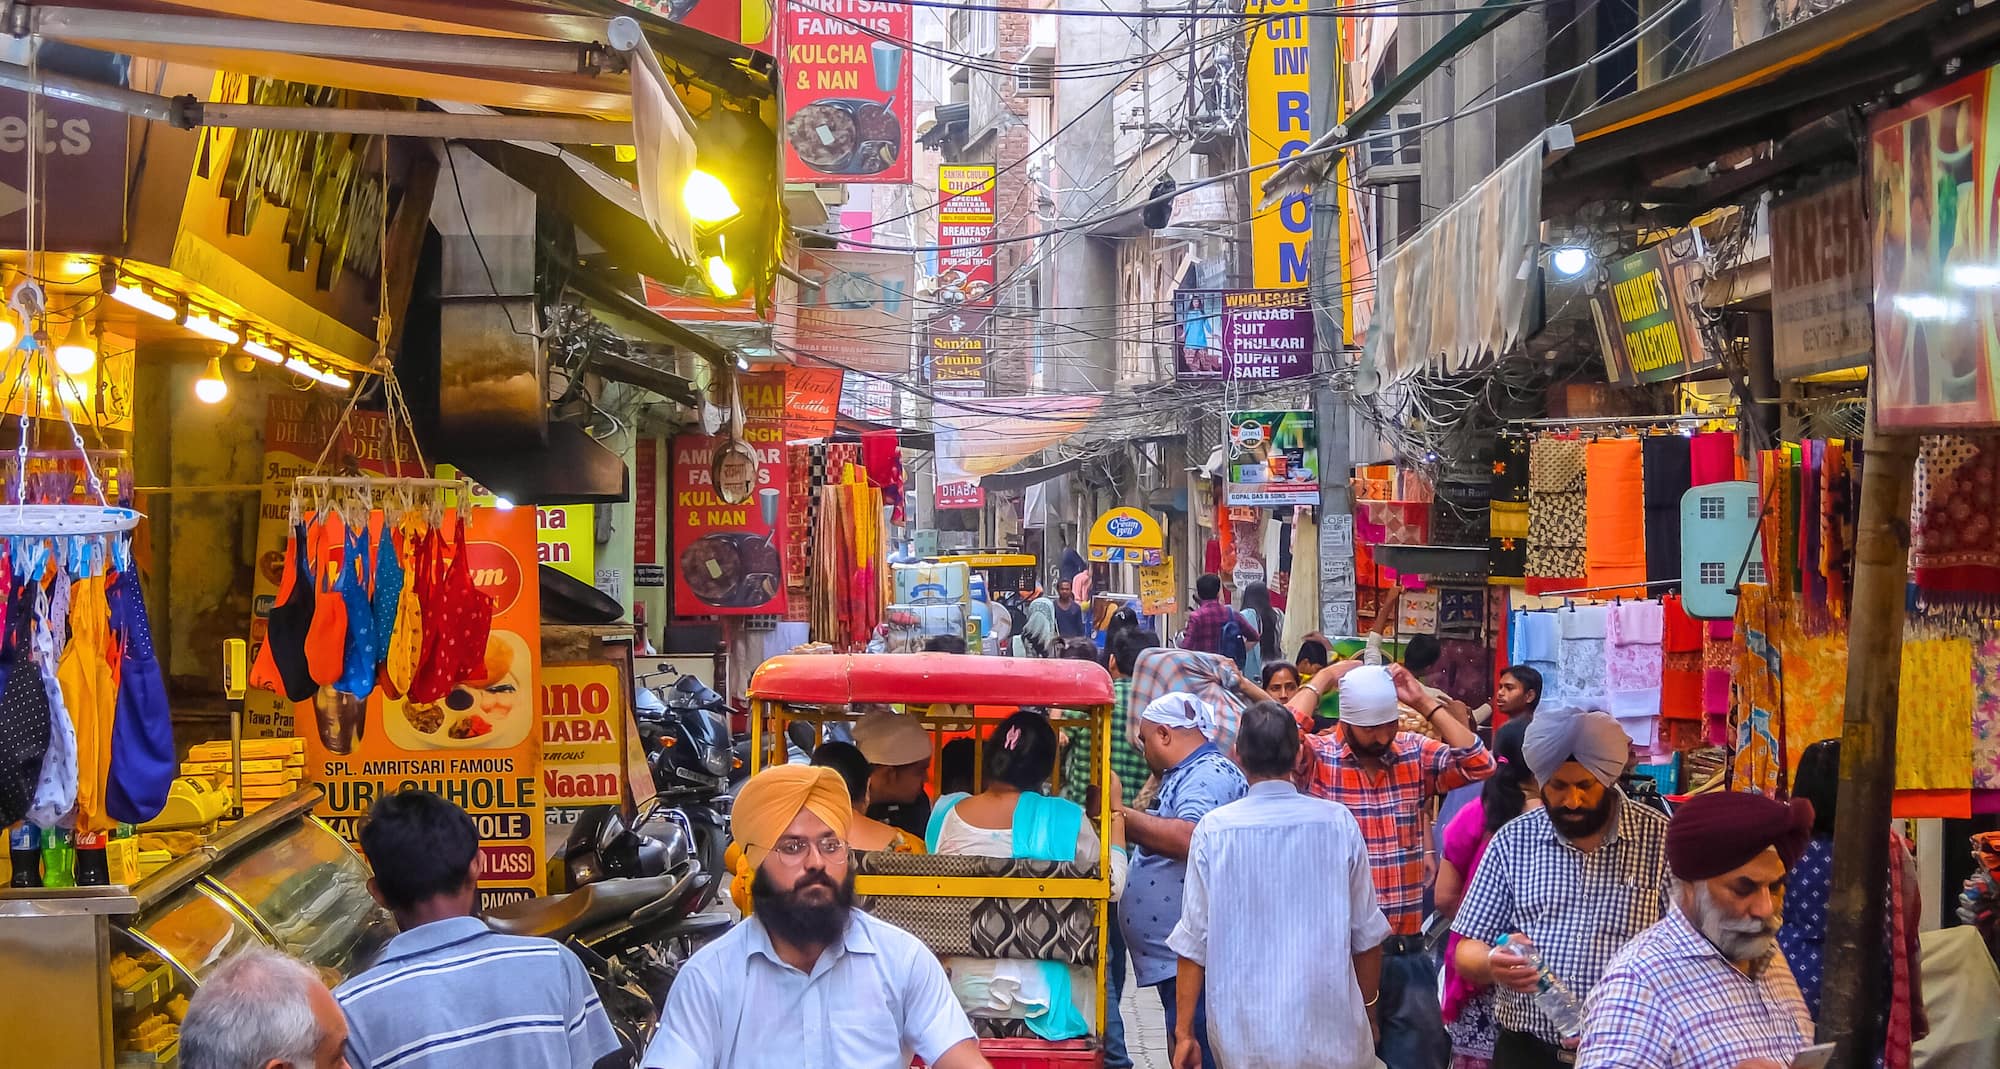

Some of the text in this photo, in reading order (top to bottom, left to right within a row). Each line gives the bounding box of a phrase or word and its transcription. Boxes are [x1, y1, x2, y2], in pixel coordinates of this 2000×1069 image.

[797, 18, 891, 36] FAMOUS
[788, 44, 867, 64] KULCHA
[796, 70, 858, 90] & NAN
[943, 227, 990, 236] BREAKFAST
[953, 237, 980, 246] LUNCH
[1226, 293, 1307, 307] WHOLESALE
[1233, 309, 1294, 321] PUNJABI
[1233, 323, 1266, 335] SUIT
[1233, 337, 1304, 349] PHULKARI
[1626, 320, 1684, 373] COLLECTION
[1233, 366, 1280, 378] SAREE
[689, 469, 770, 485] FAS
[942, 484, 977, 497] DHABA
[679, 491, 755, 506] KULA
[687, 510, 746, 527] & NAN
[1110, 519, 1139, 530] Cream
[1115, 526, 1133, 537] Bell
[248, 710, 271, 725] Tawa
[260, 728, 274, 738] with
[324, 758, 514, 776] SPL. AMRITSARI FAMOUS
[544, 769, 619, 798] Naan
[491, 853, 532, 873] LASSI
